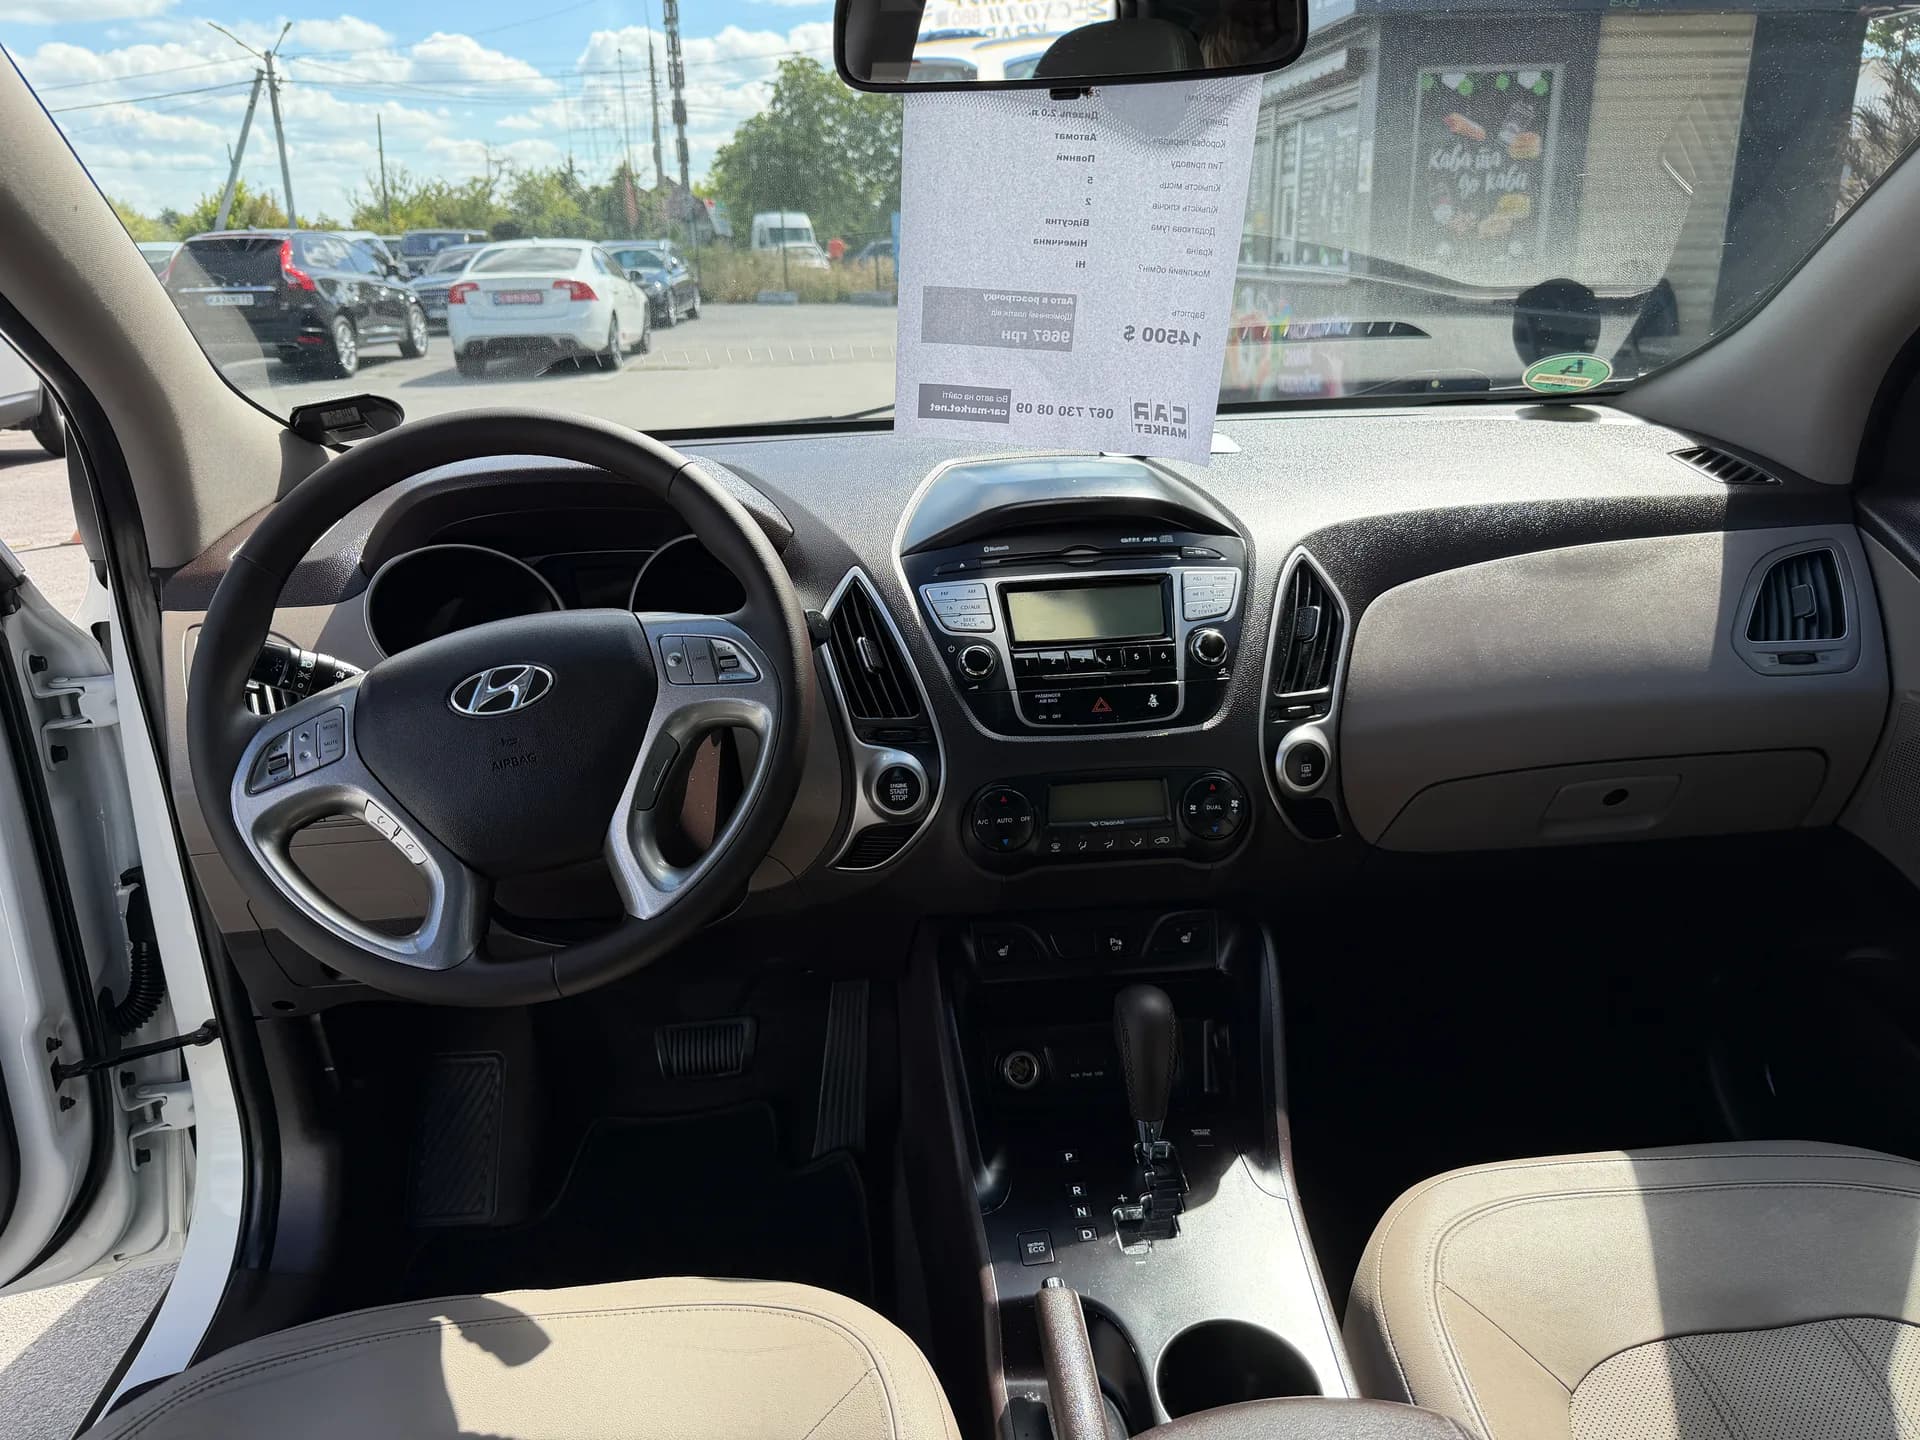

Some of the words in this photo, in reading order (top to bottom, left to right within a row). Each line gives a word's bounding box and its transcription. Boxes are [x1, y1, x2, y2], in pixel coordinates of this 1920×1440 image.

[492, 753, 537, 771] AIRBAG
[1065, 1152, 1073, 1161] P
[1072, 1186, 1081, 1195] R
[1077, 1207, 1087, 1216] N
[1082, 1230, 1092, 1239] D
[1028, 1245, 1046, 1254] ECO
